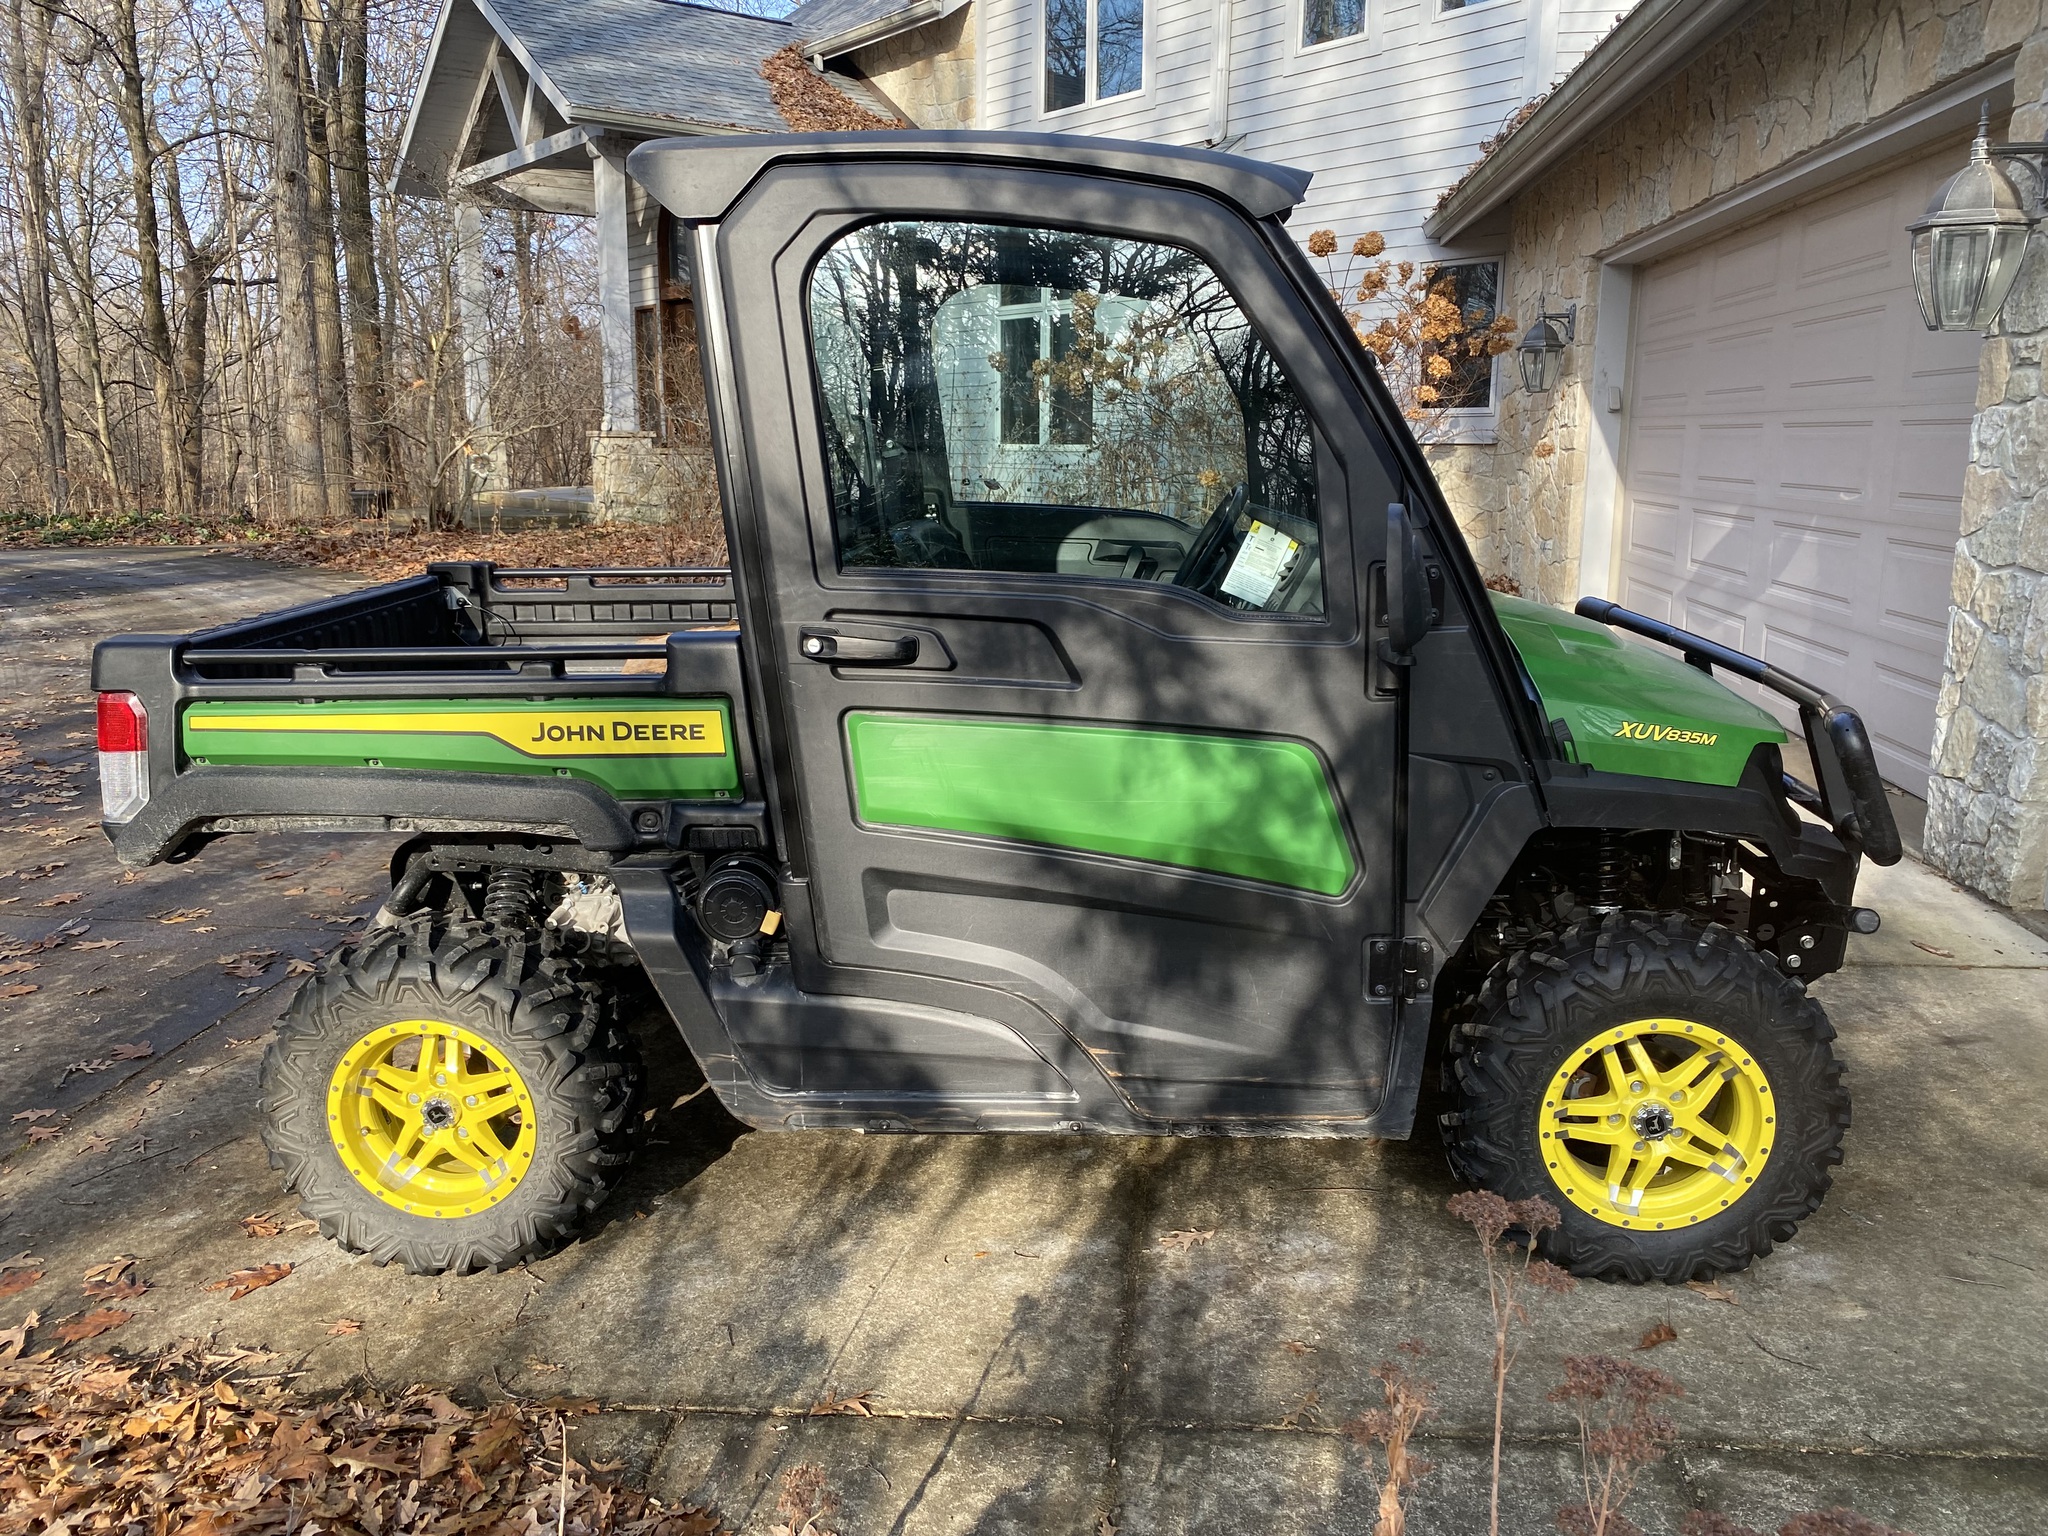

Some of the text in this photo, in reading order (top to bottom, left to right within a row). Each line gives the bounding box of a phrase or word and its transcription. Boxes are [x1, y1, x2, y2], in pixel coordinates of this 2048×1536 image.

[531, 721, 706, 742] JOHN DEERE
[1614, 720, 1718, 746] XUV835M
